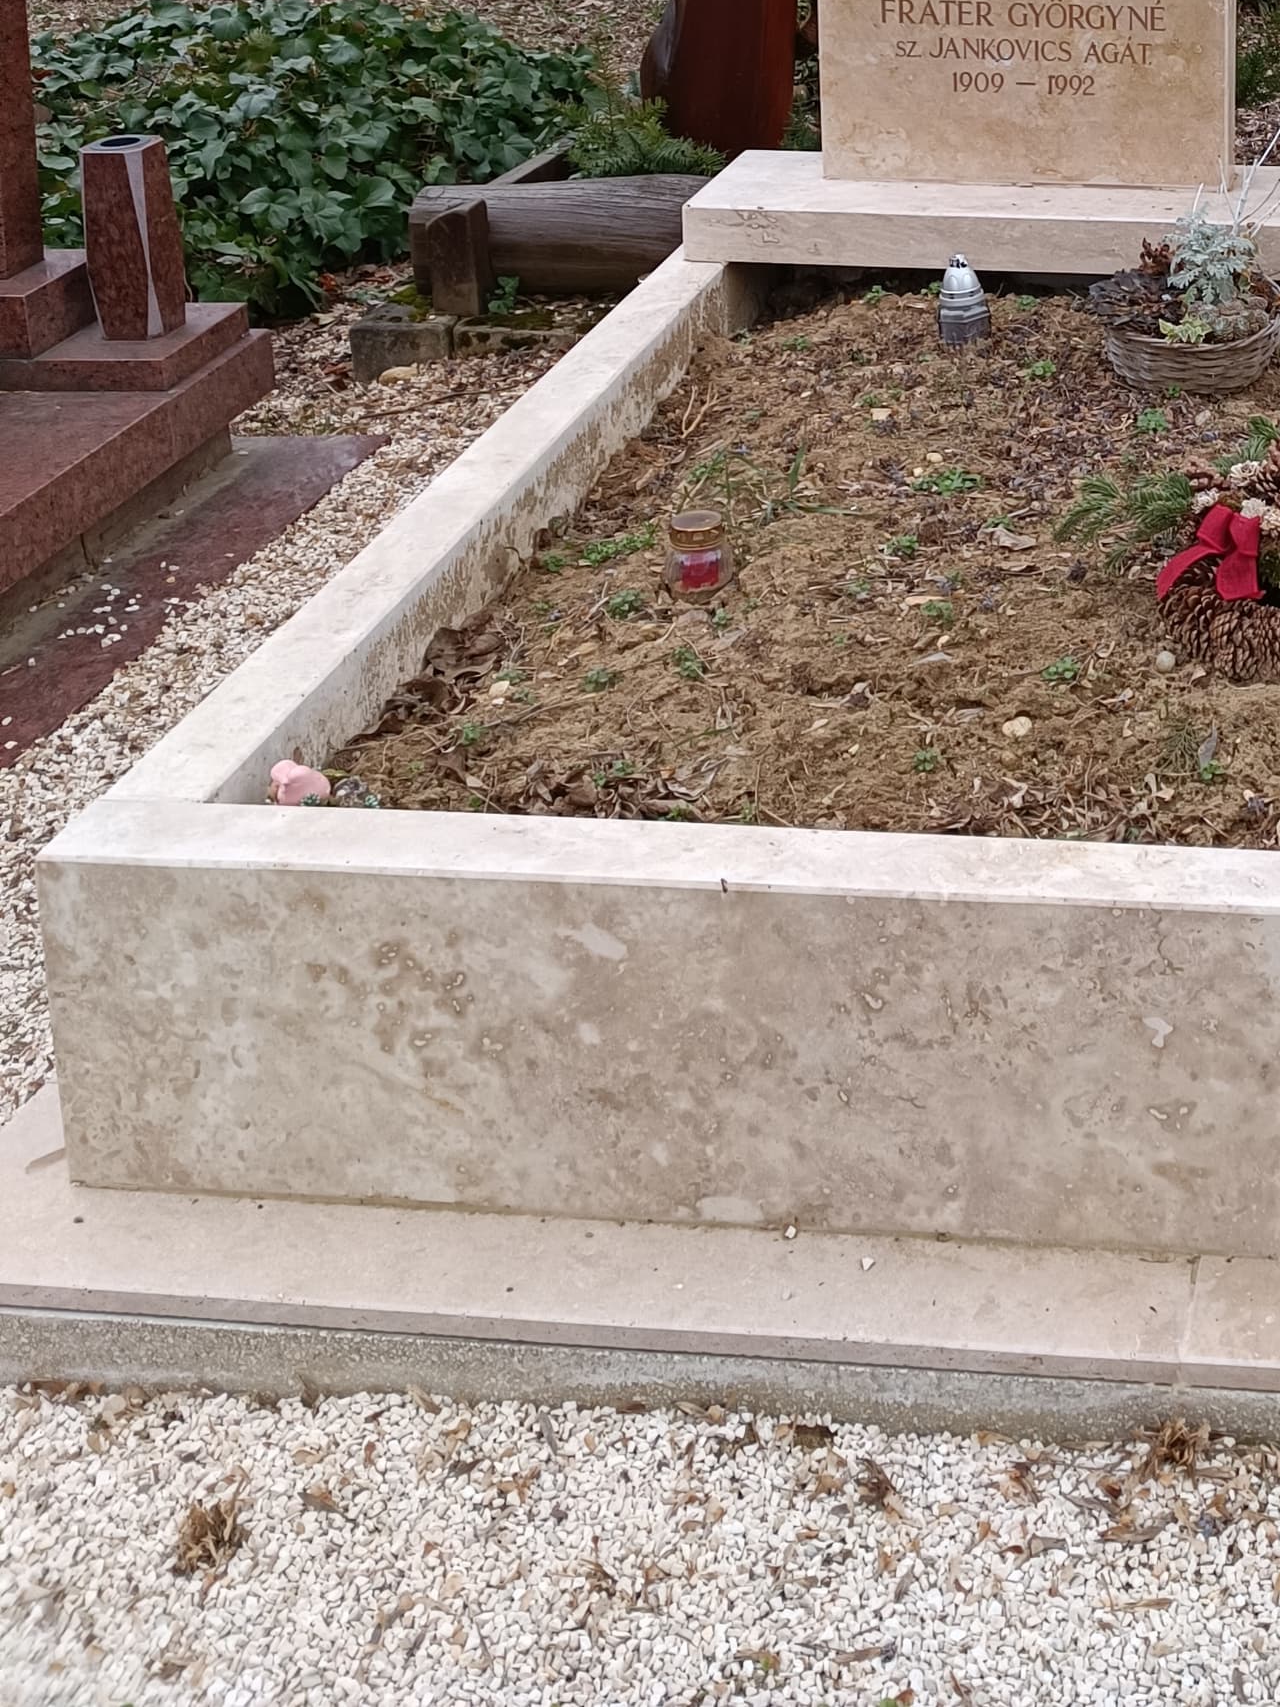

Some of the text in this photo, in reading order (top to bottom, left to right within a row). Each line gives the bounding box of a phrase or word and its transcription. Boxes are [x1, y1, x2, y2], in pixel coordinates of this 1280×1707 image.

[929, 37, 1072, 62] JANKOVICS
[952, 72, 1005, 94] 1909
[1048, 74, 1096, 95] 1992
